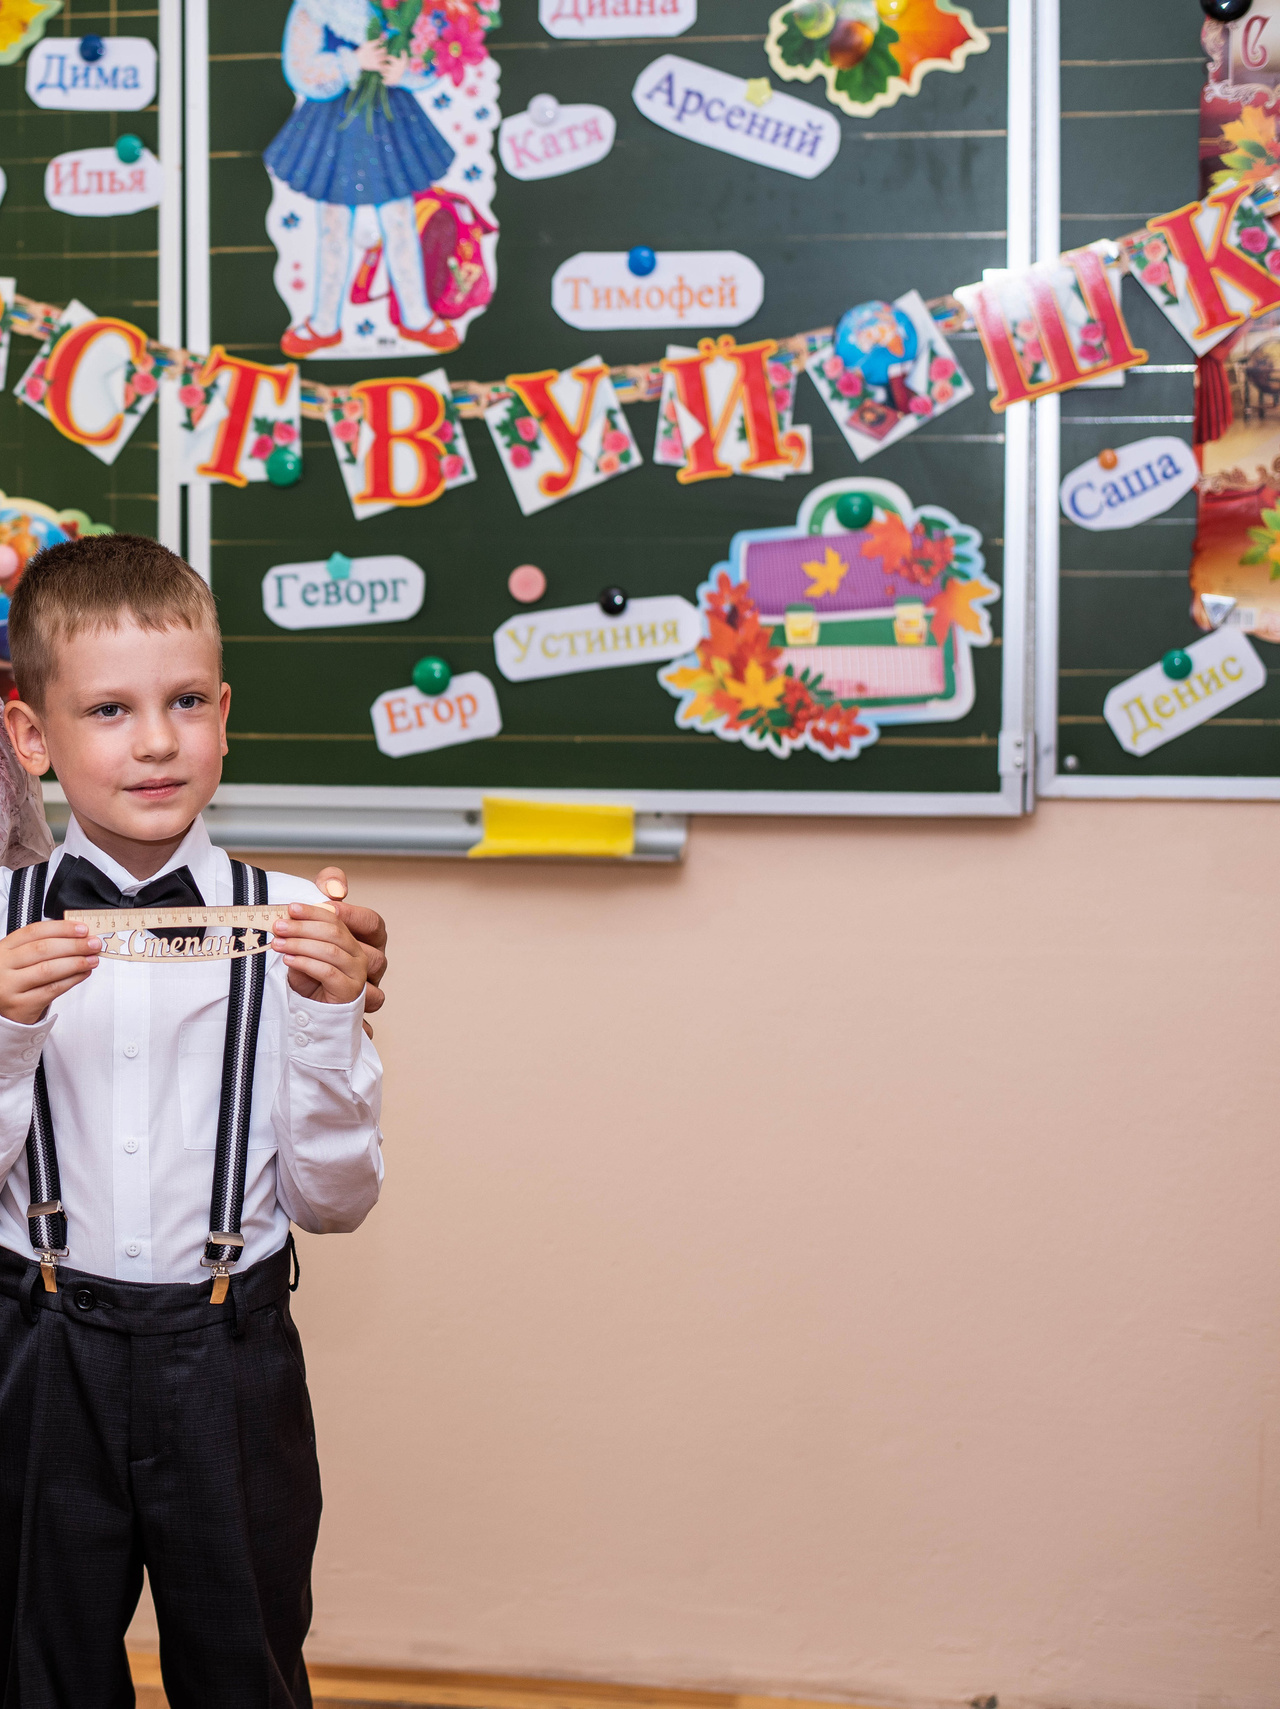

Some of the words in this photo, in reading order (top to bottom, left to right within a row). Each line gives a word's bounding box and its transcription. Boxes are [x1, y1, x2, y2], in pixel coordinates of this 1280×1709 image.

[549, 0, 679, 26] Диана
[36, 53, 141, 95] Дима
[644, 70, 826, 159] Арсений
[507, 117, 605, 170] Катя
[52, 161, 147, 195] Илья
[563, 275, 738, 319] Тимофей
[1070, 454, 1182, 520] Саша
[274, 573, 408, 614] Геворг
[506, 619, 680, 663] Устиния
[383, 693, 478, 735] Егор
[1122, 656, 1244, 747] Денис
[128, 928, 239, 957] Степан
